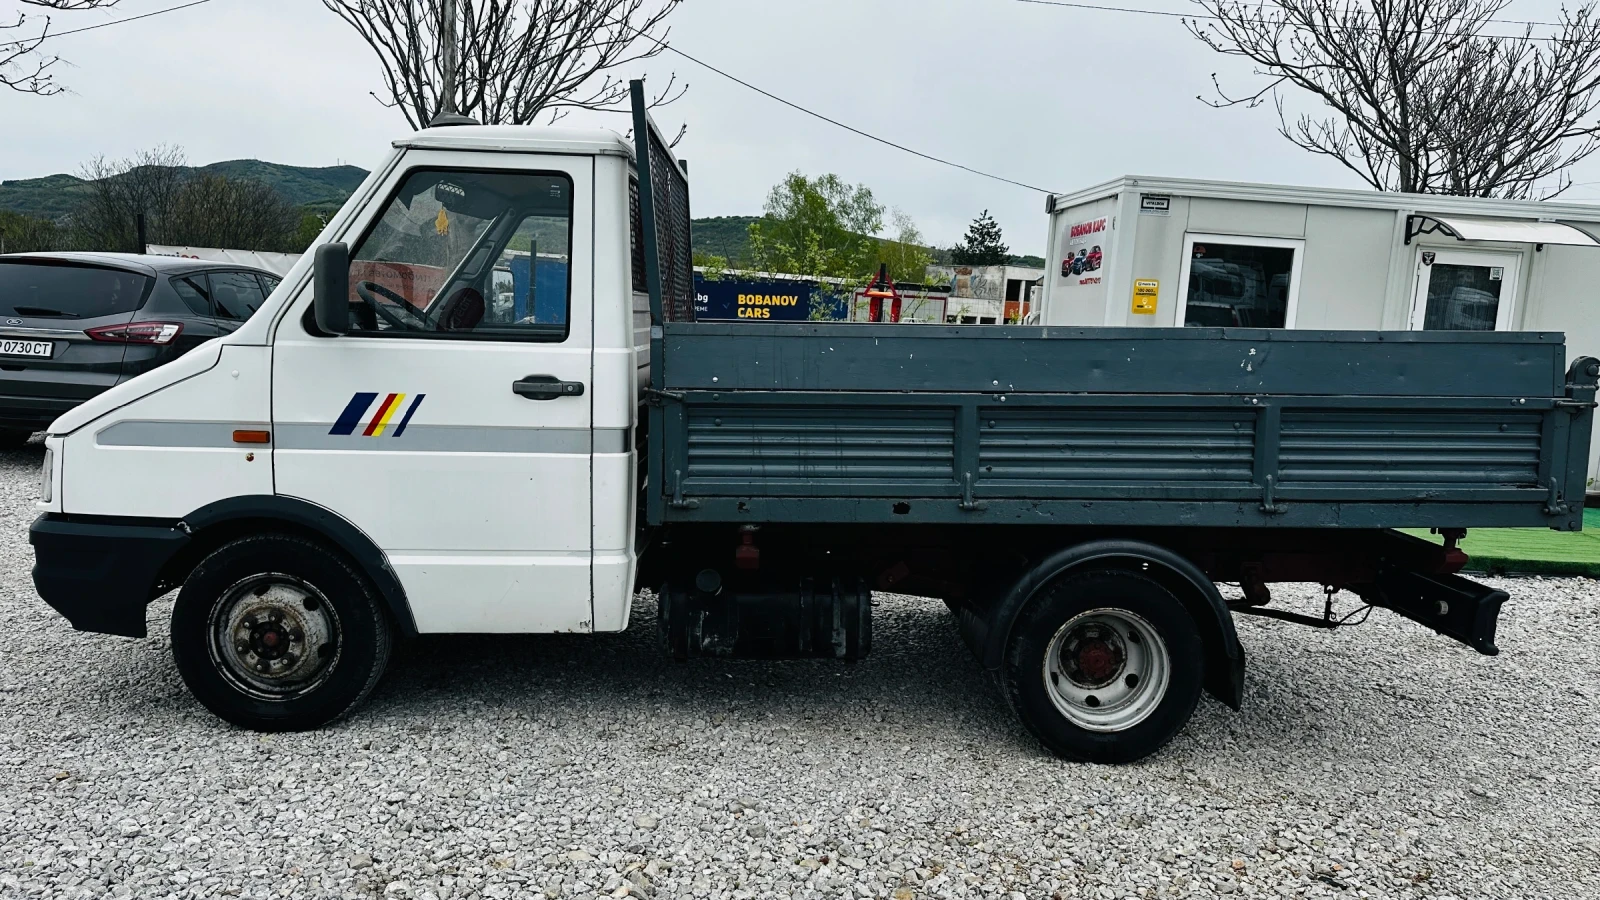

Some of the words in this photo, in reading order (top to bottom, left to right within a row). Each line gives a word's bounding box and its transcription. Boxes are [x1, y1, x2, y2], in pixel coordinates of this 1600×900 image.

[1070, 221, 1093, 238] БОБАНОВ
[1092, 217, 1107, 233] КАРС
[737, 294, 799, 306] BOBANOV
[737, 307, 771, 319] CARS
[4, 341, 32, 354] 0730
[33, 342, 50, 355] CT
